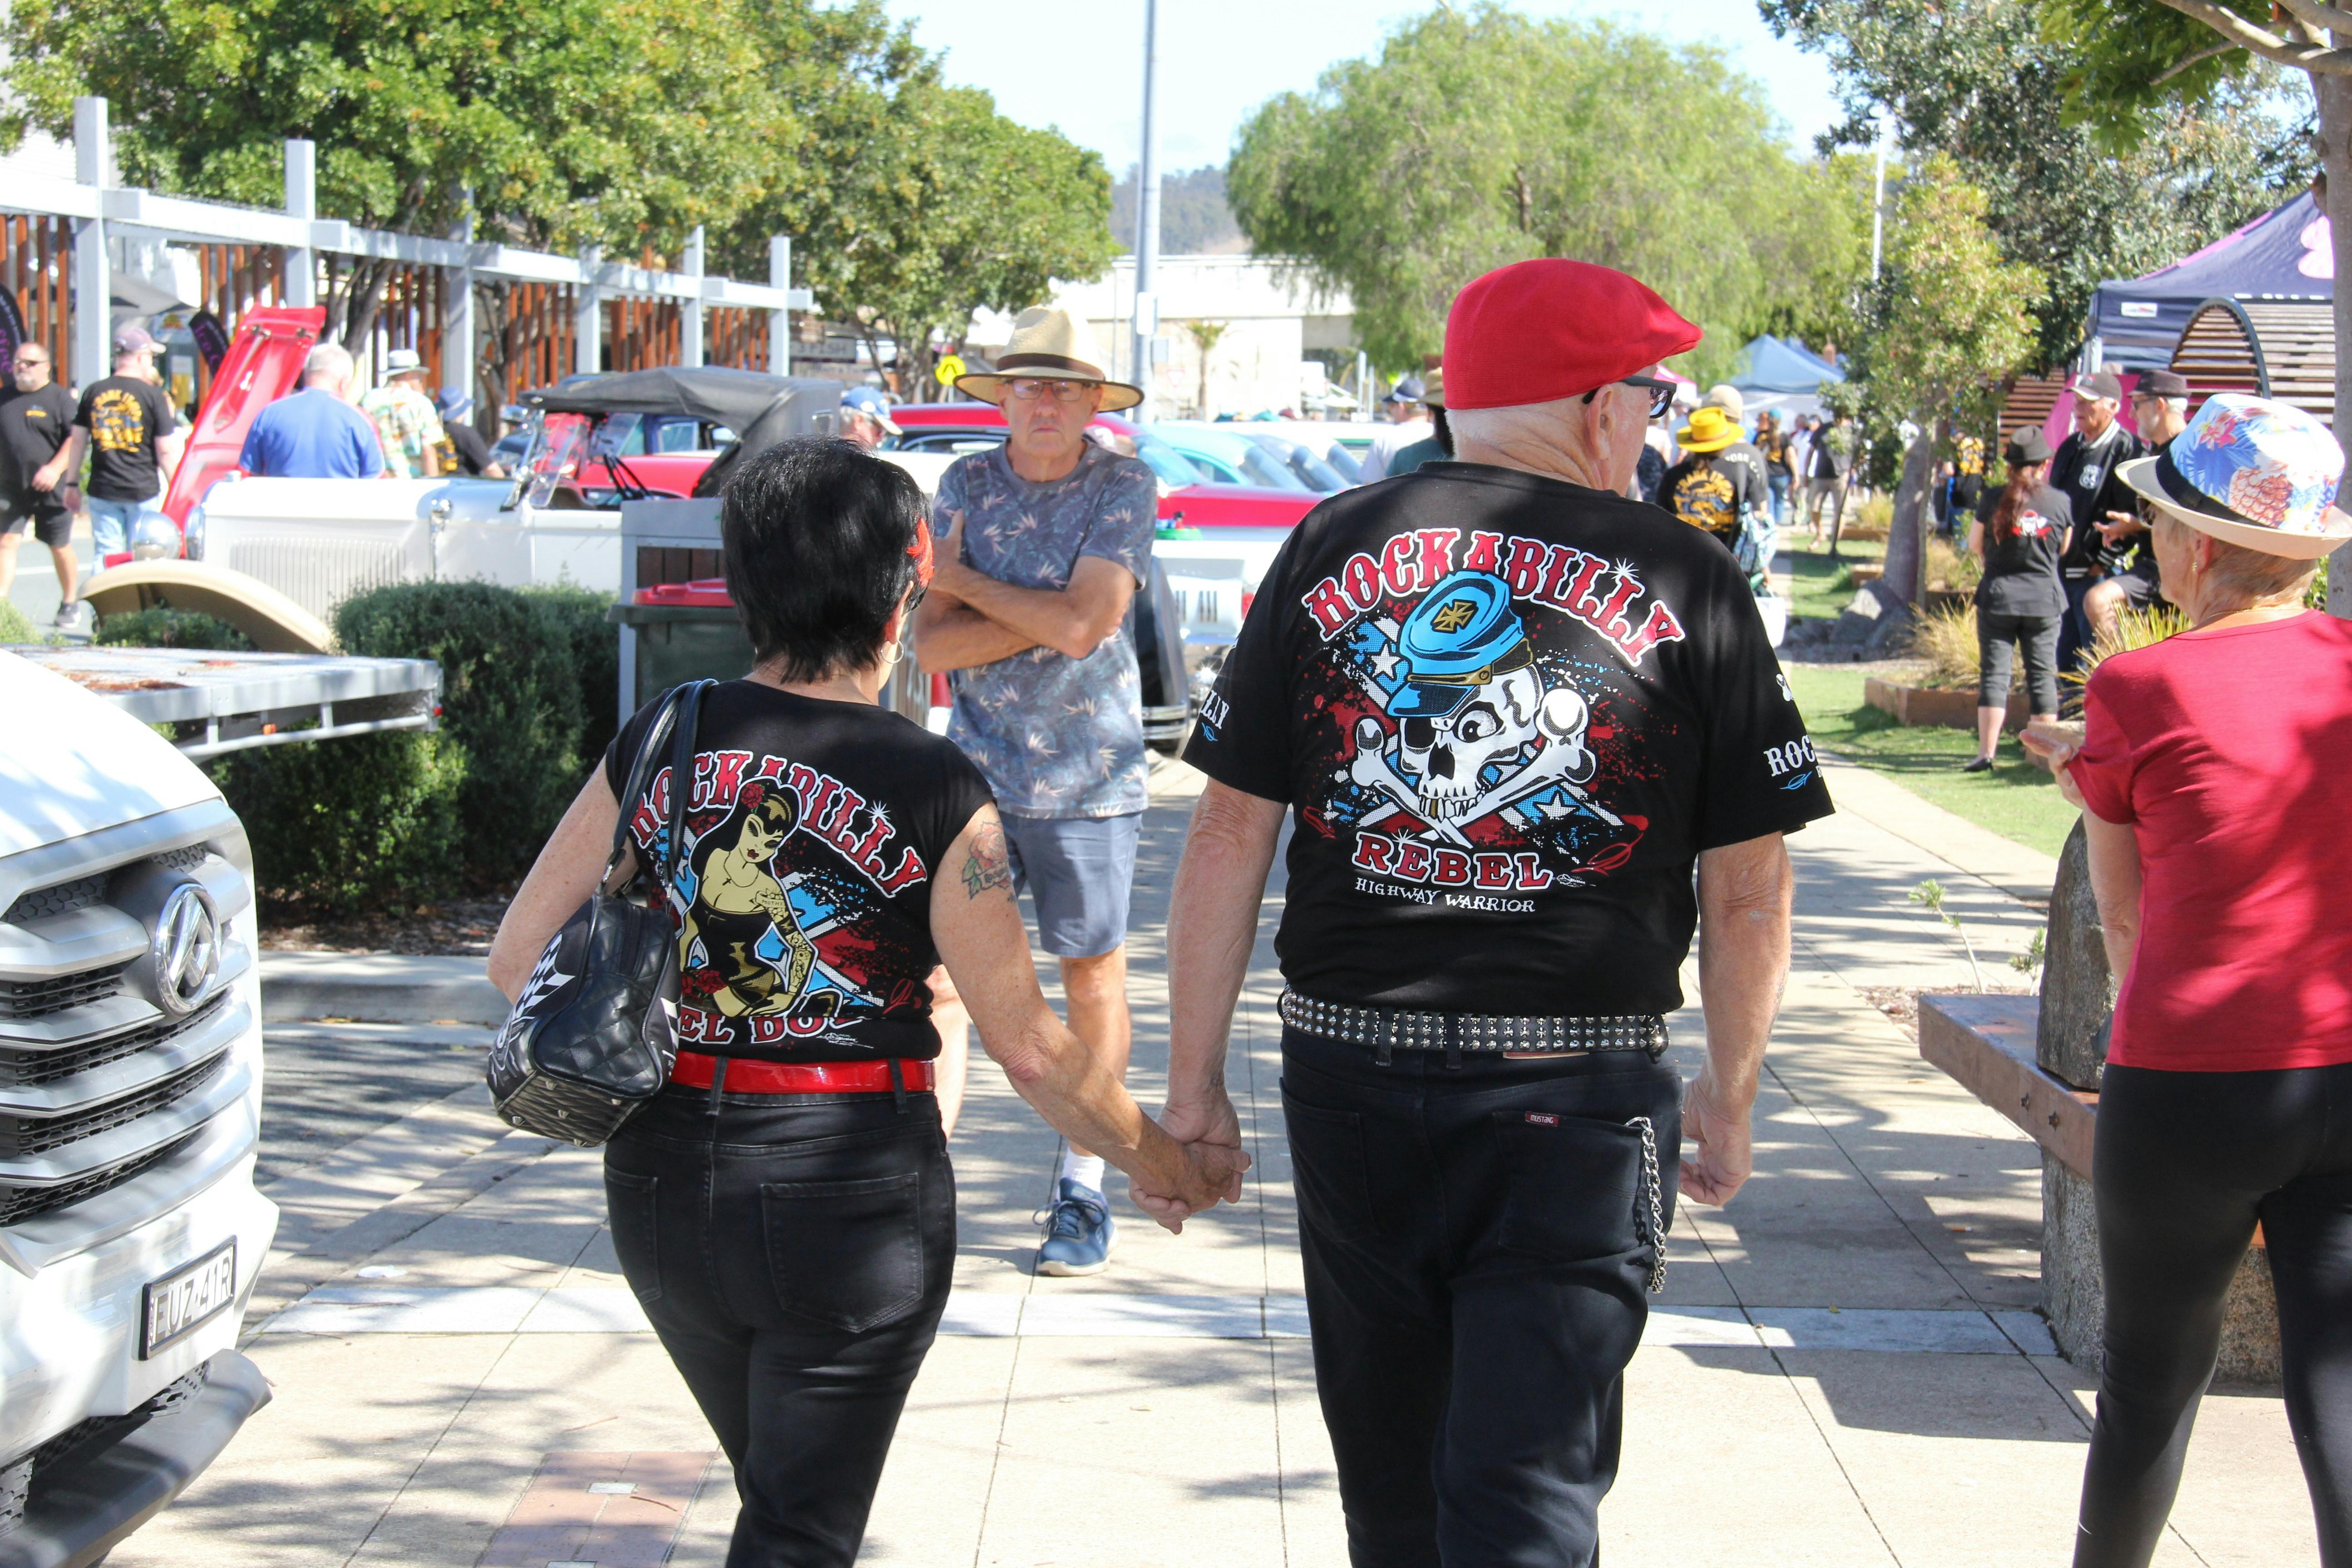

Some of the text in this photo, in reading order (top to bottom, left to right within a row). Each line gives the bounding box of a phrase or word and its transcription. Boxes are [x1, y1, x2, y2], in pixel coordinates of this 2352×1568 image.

[1301, 528, 1686, 667] ROCKABILLY
[1352, 831, 1553, 890] REBEL
[1355, 877, 1535, 912] HIGHWAY WARRIOR
